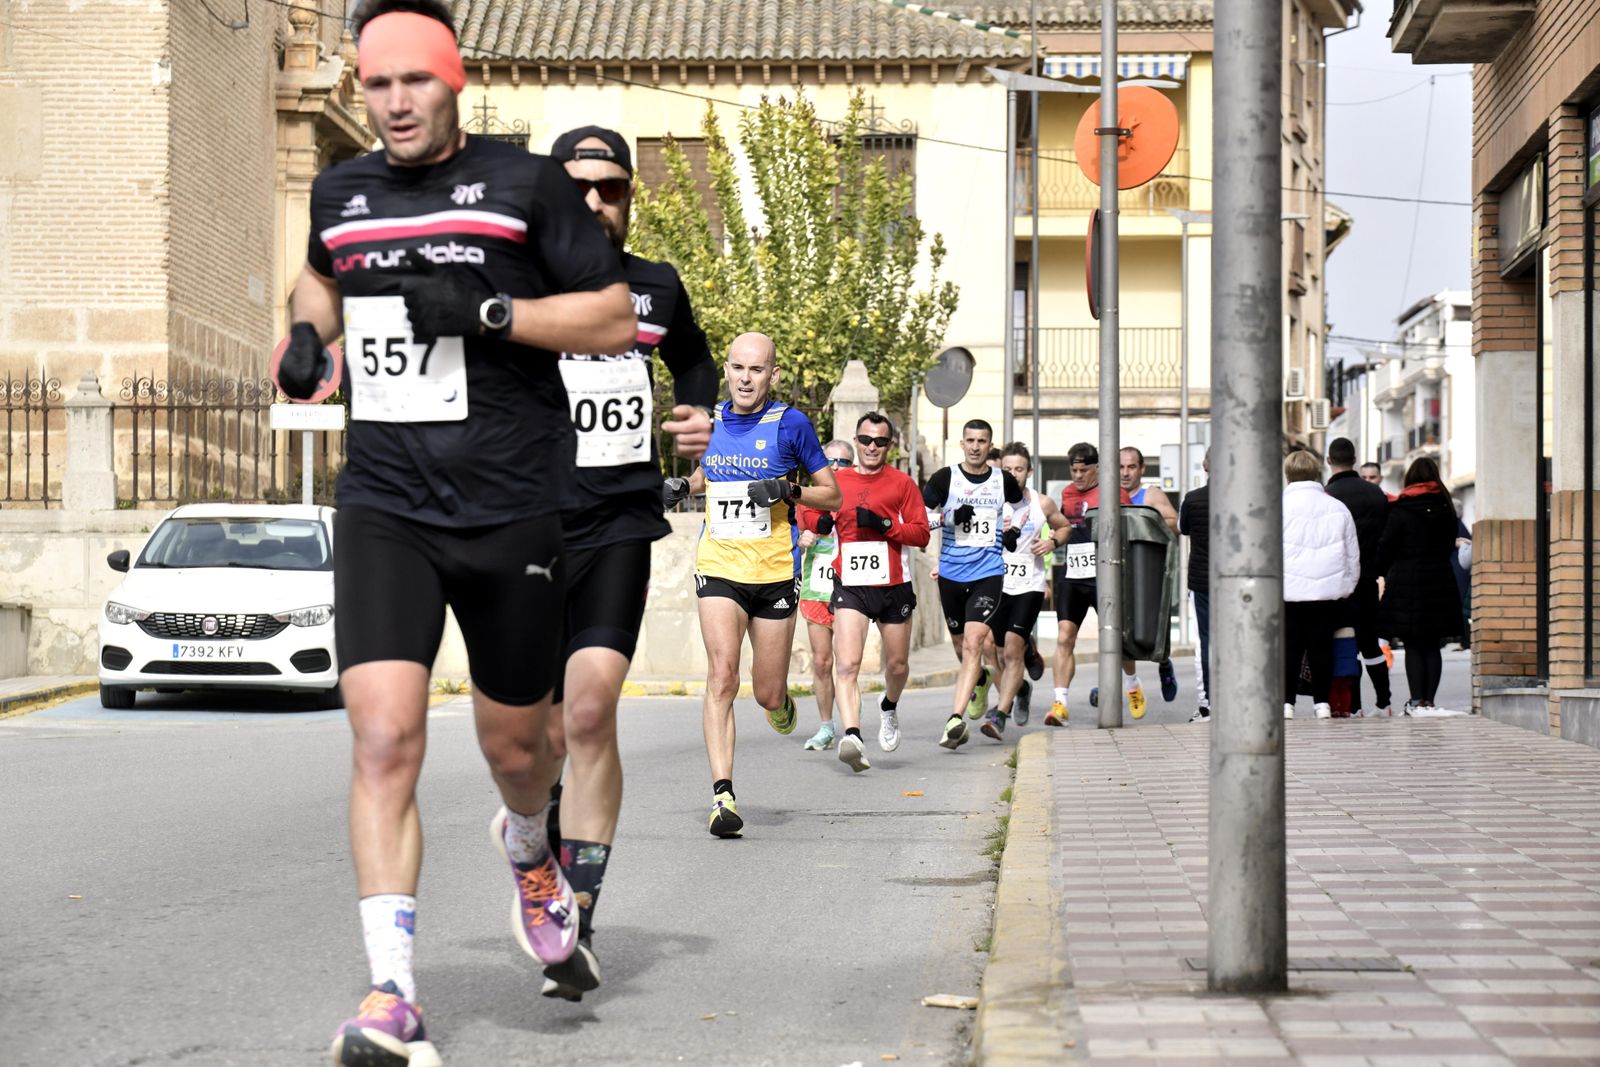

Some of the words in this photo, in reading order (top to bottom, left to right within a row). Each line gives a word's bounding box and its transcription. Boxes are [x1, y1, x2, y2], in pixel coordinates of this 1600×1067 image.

[362, 338, 437, 377] 557
[705, 453, 769, 471] agustinos
[718, 500, 756, 520] 771
[962, 521, 990, 534] 813
[850, 555, 880, 571] 578
[1068, 554, 1097, 569] 3135
[180, 645, 215, 658] 7392
[219, 645, 244, 658] KFV
